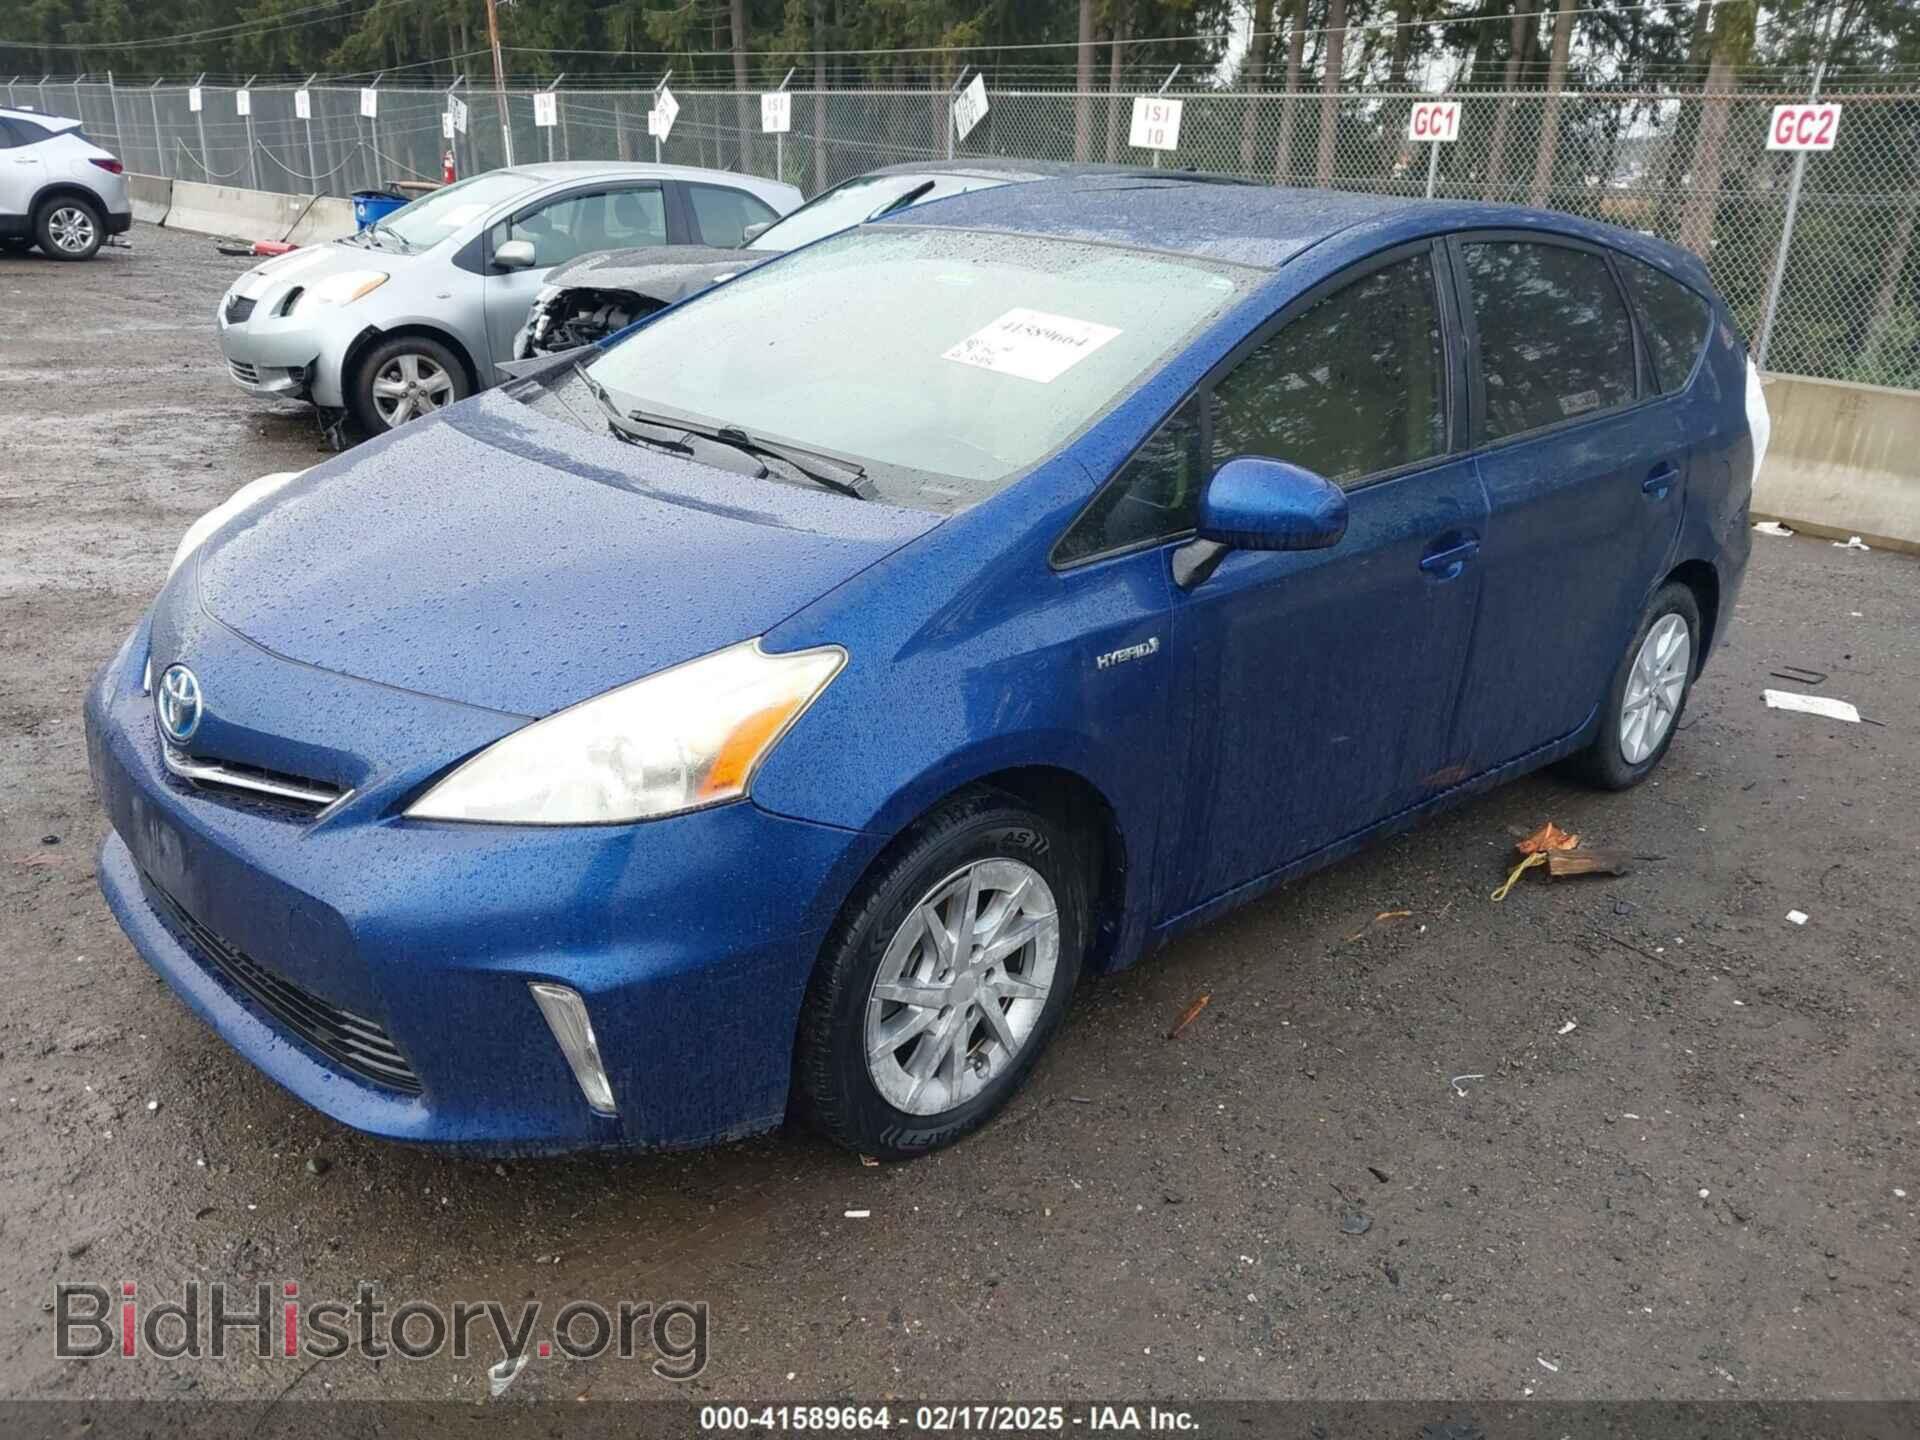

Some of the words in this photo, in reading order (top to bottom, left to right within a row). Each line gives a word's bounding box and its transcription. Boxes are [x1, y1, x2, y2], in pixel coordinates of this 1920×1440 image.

[1415, 106, 1455, 136] GC1
[1775, 110, 1834, 144] GC2
[1096, 643, 1151, 669] HYBRID
